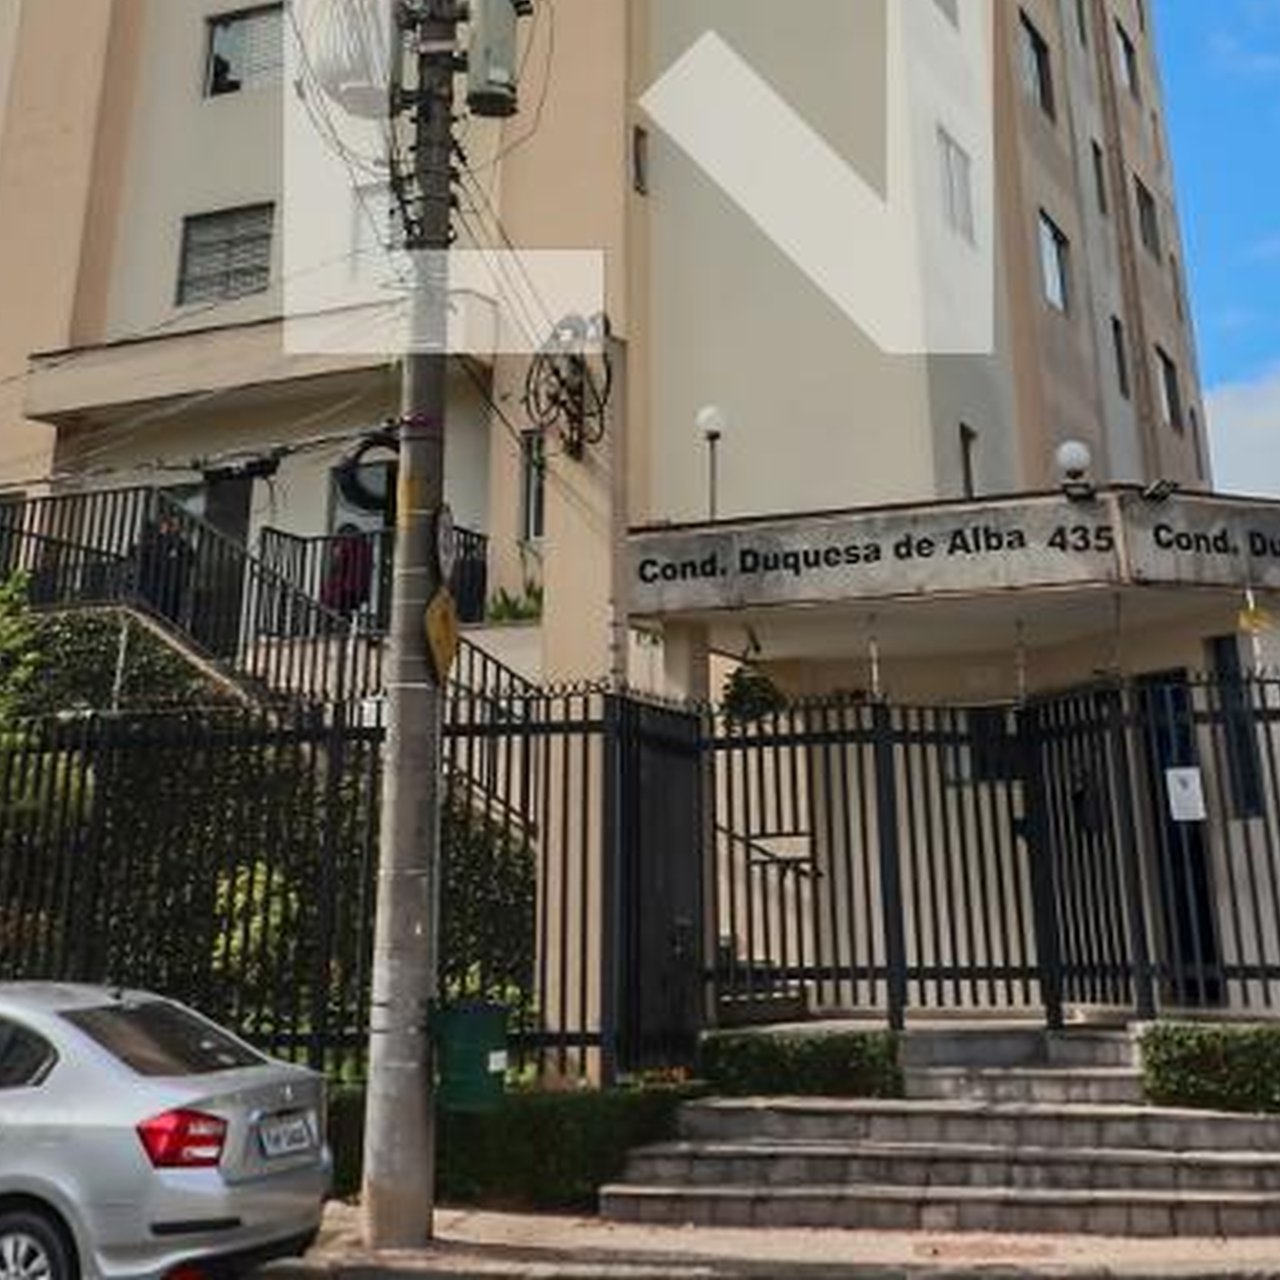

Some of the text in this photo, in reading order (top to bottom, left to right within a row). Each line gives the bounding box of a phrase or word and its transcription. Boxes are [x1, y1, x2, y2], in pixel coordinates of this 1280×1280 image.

[638, 526, 1114, 583] Cond. Duquesa de Alba 435
[1153, 524, 1238, 554] Cond.
